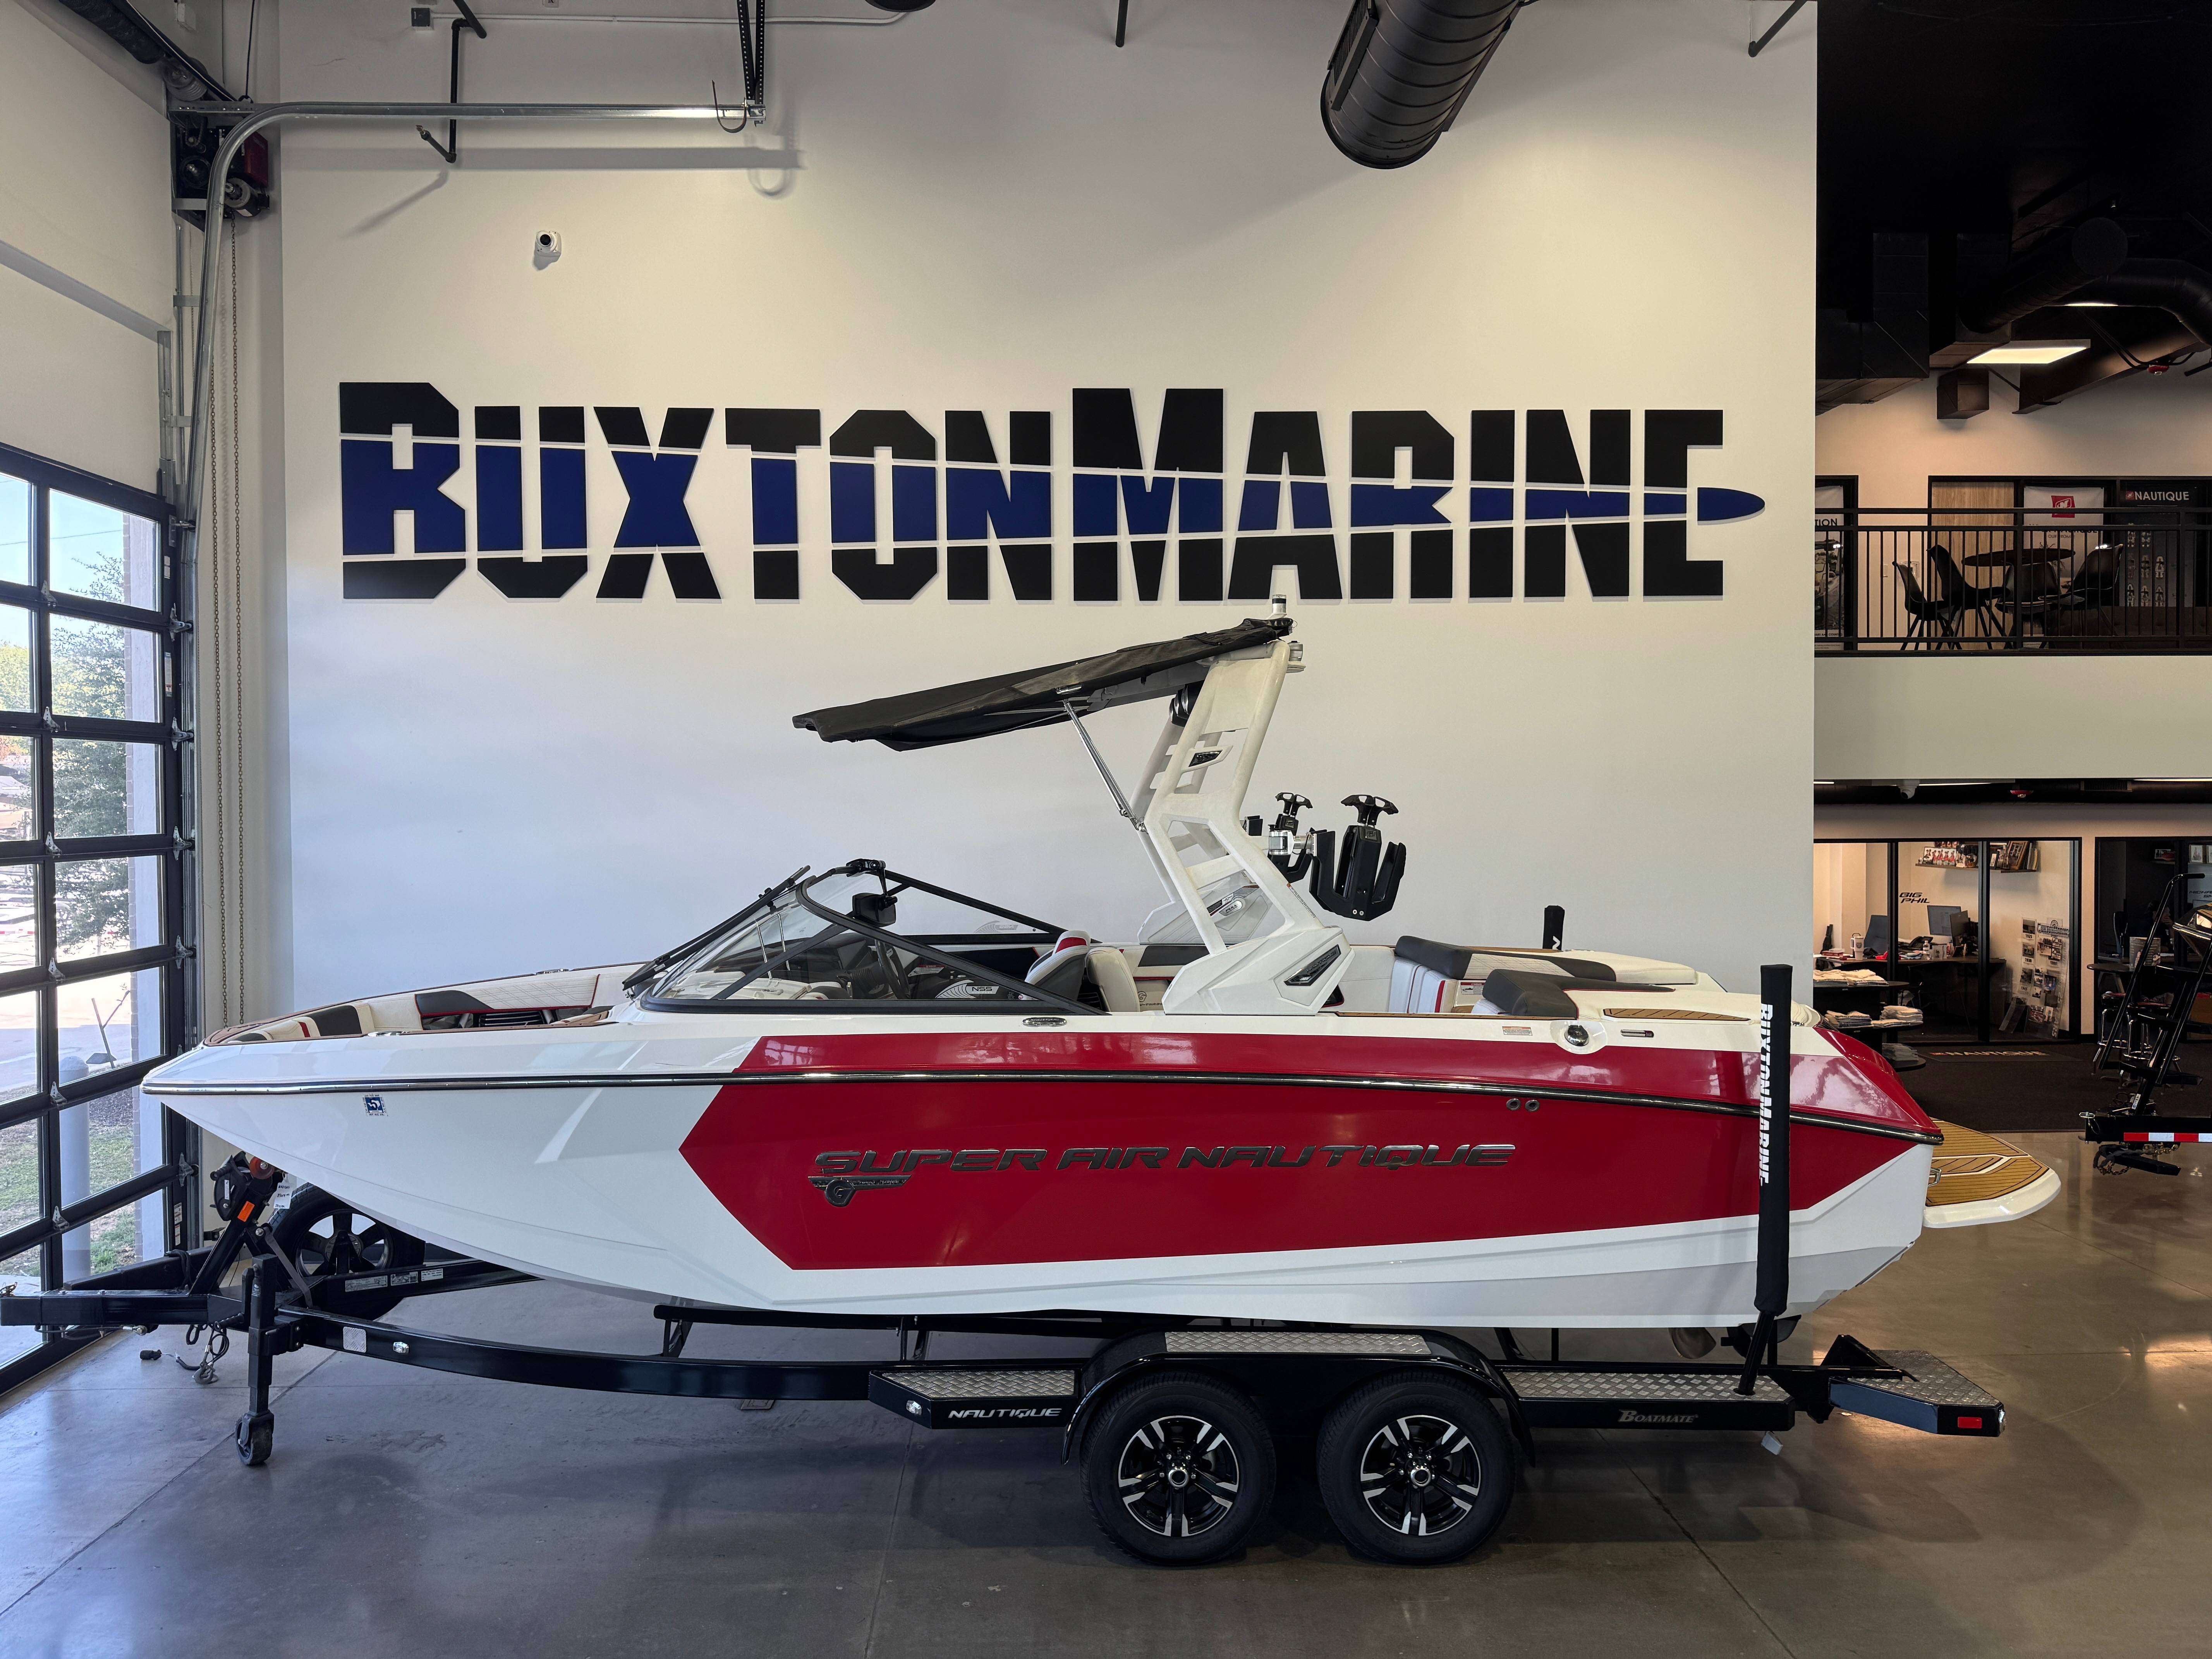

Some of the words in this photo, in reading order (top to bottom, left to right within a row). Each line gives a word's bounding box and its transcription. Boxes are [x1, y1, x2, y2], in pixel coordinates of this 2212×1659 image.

[2135, 491, 2190, 501] NAUTIQUE
[818, 1148, 1048, 1173] SUPER
[1056, 1147, 1168, 1170] AIR
[1176, 1144, 1516, 1170] NAUTIQUE
[948, 1408, 1062, 1419] NAUTIQUE
